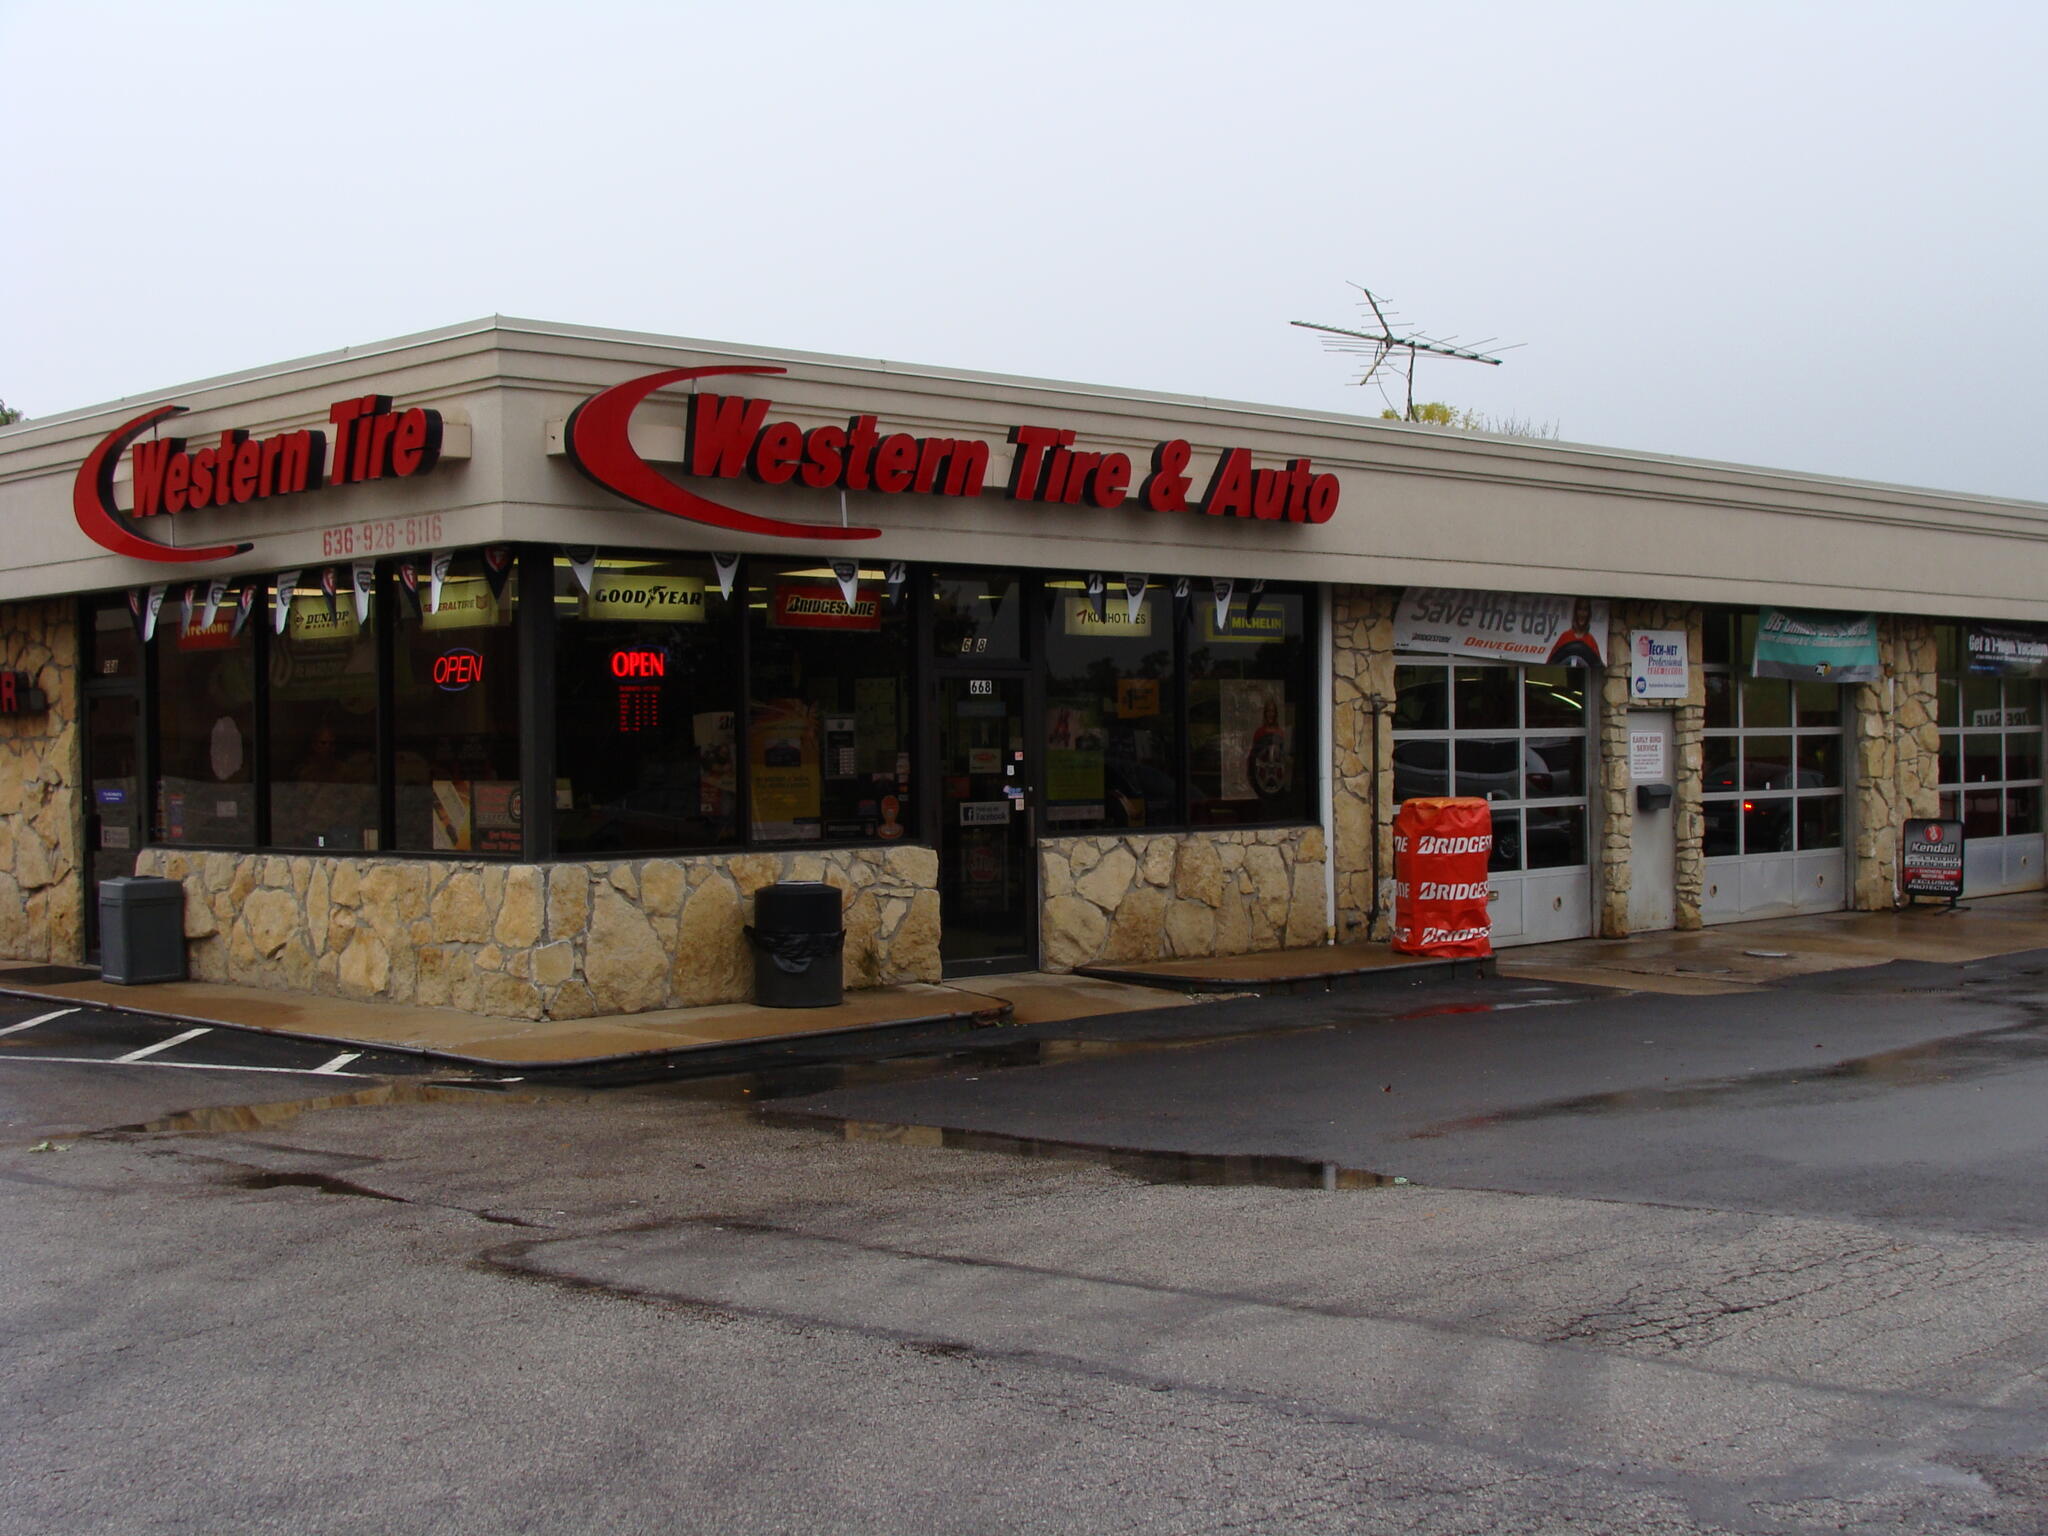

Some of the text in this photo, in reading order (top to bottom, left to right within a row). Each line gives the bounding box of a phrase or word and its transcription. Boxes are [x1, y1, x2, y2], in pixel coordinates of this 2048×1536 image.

[133, 395, 438, 518] Western Tire
[688, 393, 1341, 525] Western Tire & Auto
[787, 595, 876, 616] BRIDGESTONE
[1410, 598, 1473, 627] Save
[1478, 601, 1516, 633] the
[1087, 610, 1146, 625] KUHO TIES
[182, 622, 230, 637] iretone
[1969, 634, 1983, 652] Get
[433, 655, 485, 684] OPEN
[611, 651, 665, 677] OPEN
[971, 681, 991, 694] 668
[1417, 834, 1492, 855] BRIDGES
[1911, 842, 1956, 854] Kendall
